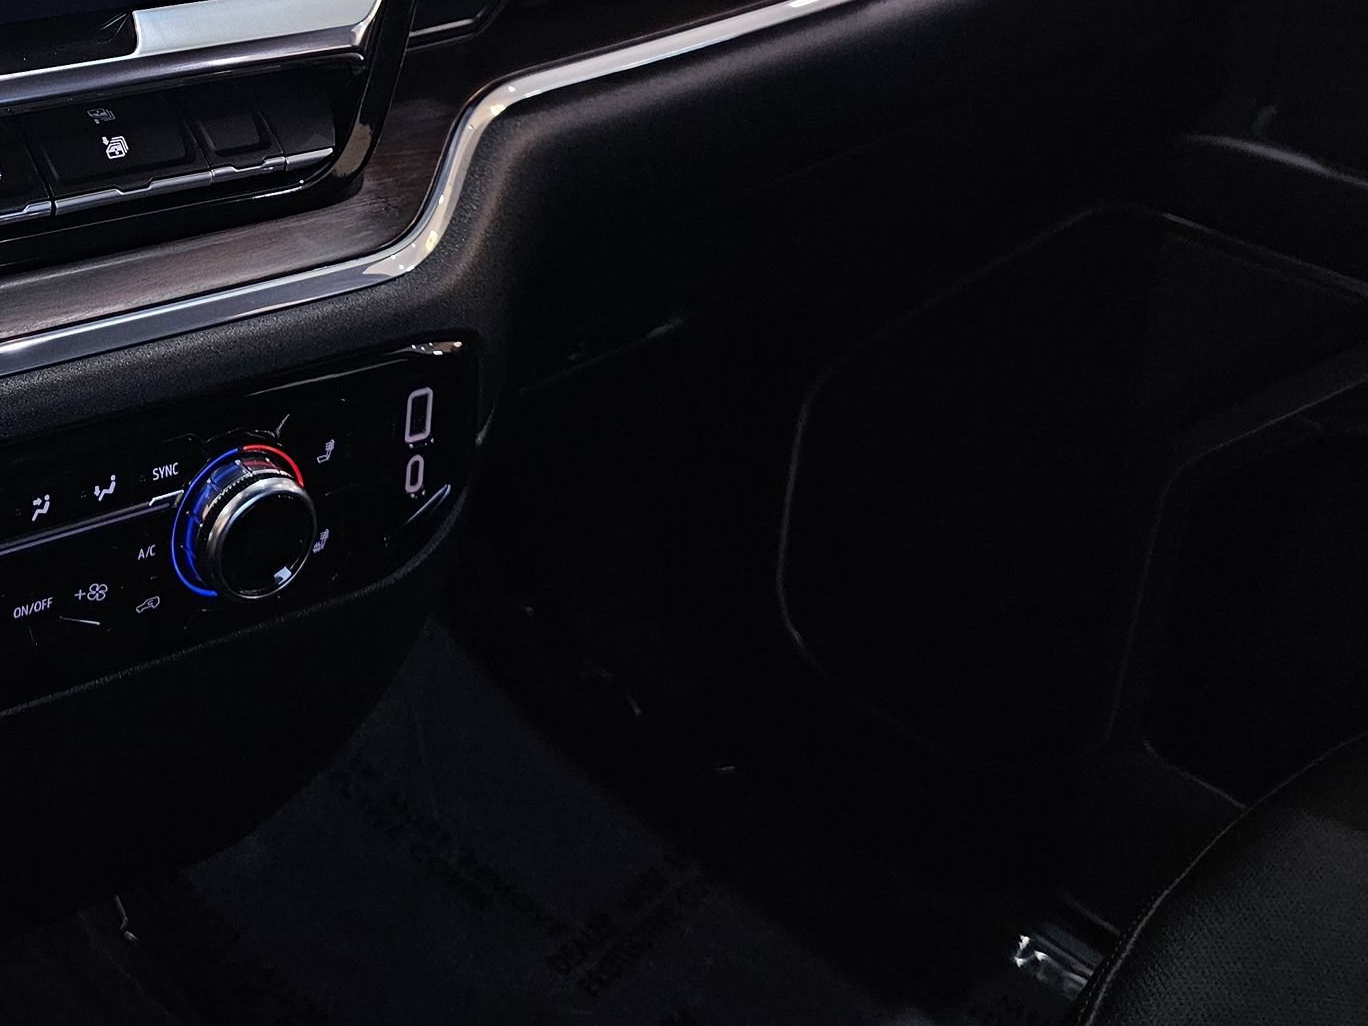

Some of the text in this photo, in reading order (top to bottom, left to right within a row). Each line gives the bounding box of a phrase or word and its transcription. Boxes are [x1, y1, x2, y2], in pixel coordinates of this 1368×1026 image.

[152, 462, 179, 481] SYNC
[137, 544, 156, 561] A/C
[13, 596, 53, 619] ON/OFF
